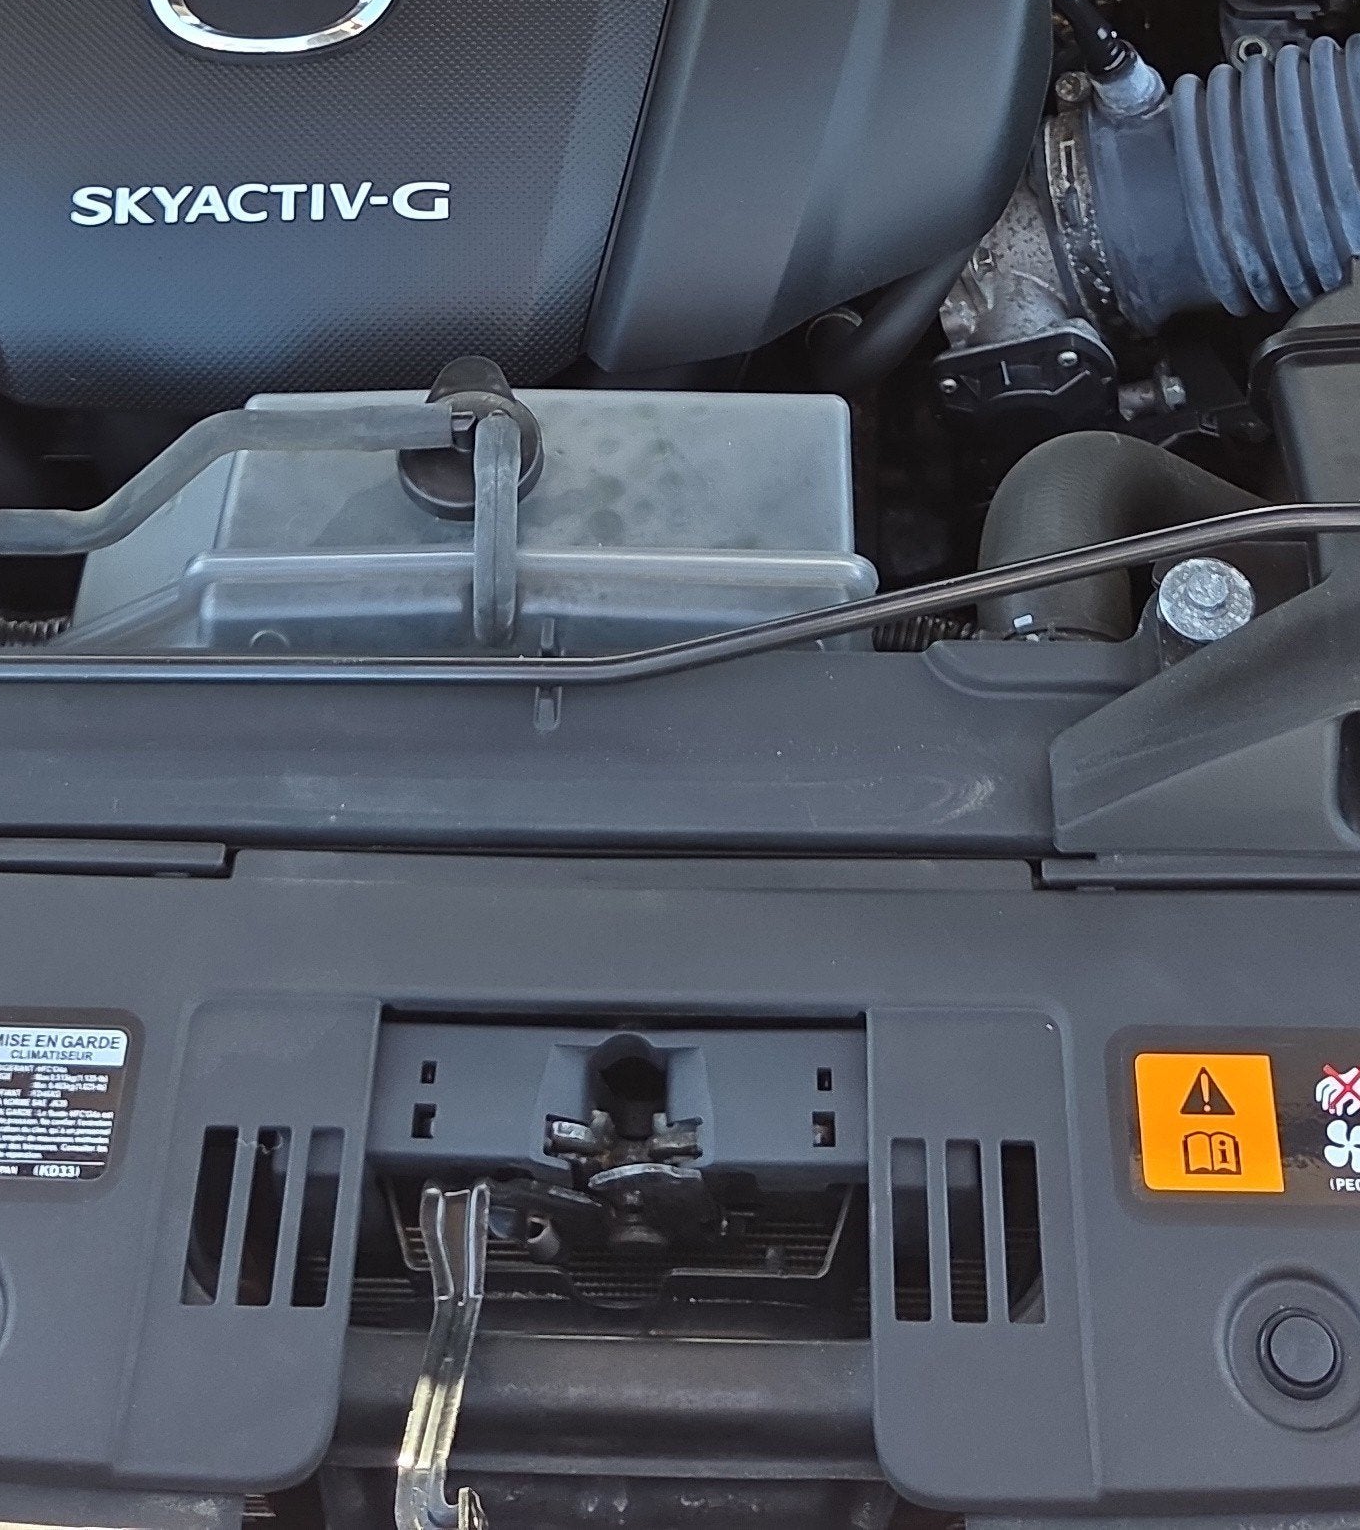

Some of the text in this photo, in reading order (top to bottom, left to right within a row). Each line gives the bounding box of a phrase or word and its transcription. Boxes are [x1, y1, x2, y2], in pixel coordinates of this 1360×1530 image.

[69, 181, 451, 226] SKYACTIV-G
[35, 1035, 58, 1048] EN
[61, 1036, 121, 1050] GARDE
[10, 1050, 94, 1062] CLIMATISEUR
